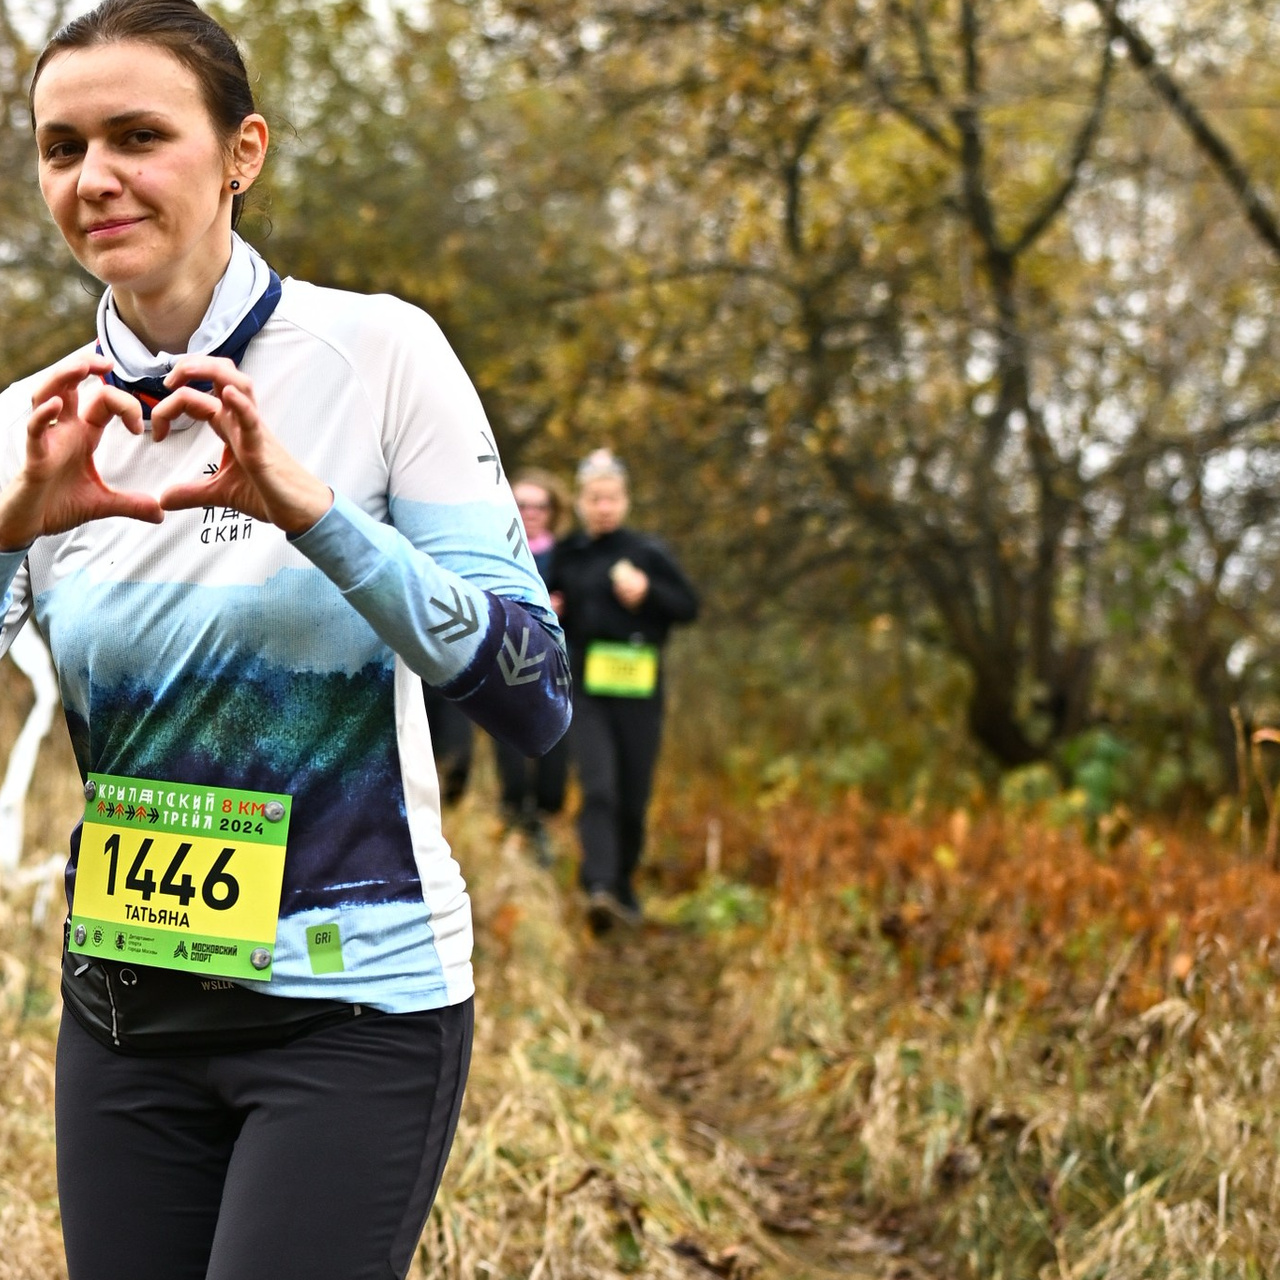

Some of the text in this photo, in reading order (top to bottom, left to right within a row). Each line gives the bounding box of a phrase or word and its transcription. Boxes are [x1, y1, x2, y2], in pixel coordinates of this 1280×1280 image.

[98, 783, 216, 813] КРЫЛАТСКИЙ
[221, 799, 233, 814] 8
[163, 810, 214, 830] ТРЕЙЛ
[220, 818, 264, 835] 2024
[103, 833, 240, 911] 1446
[124, 904, 190, 928] ТАТЬЯНА
[190, 951, 212, 963] СПОРТ
[191, 942, 238, 956] МОСКОВСКИЙ
